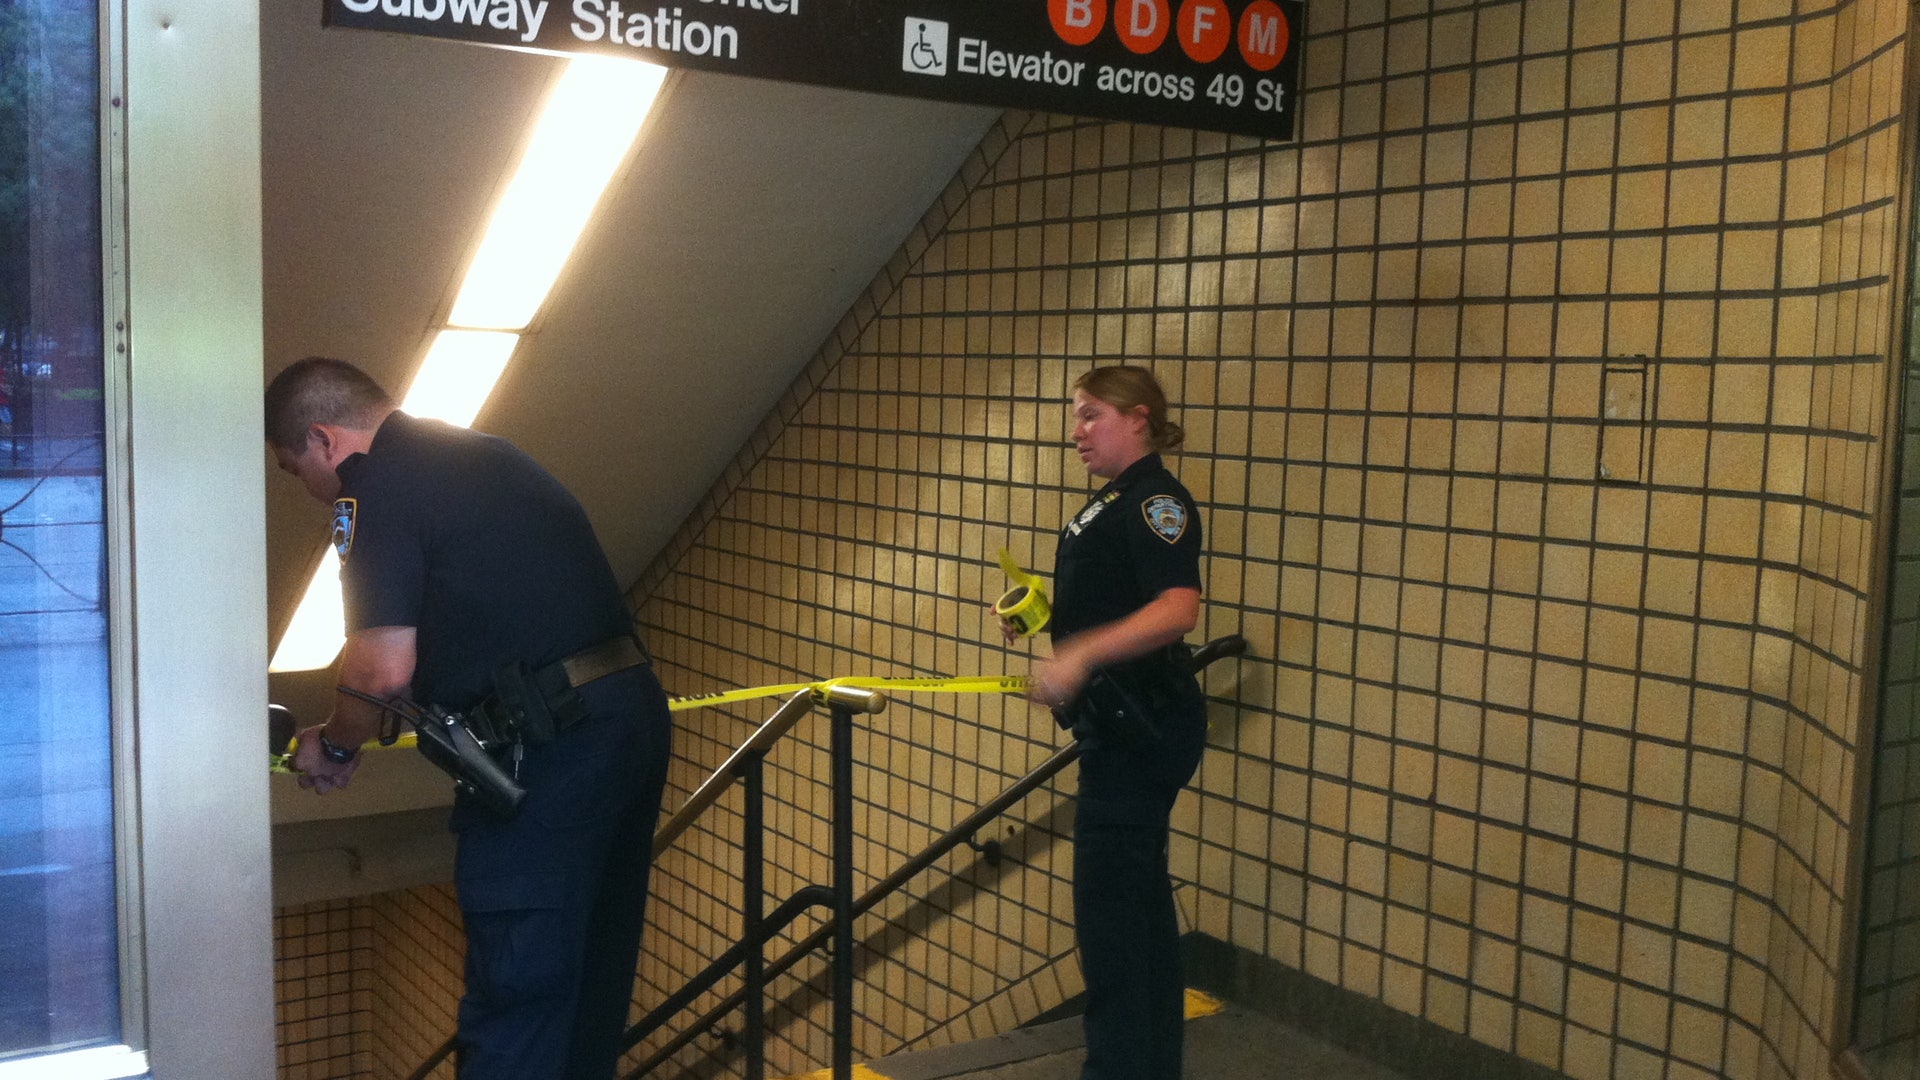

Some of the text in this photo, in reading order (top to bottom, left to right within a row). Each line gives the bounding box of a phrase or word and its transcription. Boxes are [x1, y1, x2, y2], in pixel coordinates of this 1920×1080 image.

[342, 0, 738, 59] ubway Station
[1065, 0, 1278, 55] B D F M
[957, 37, 1284, 112] Elevator across 49 St
